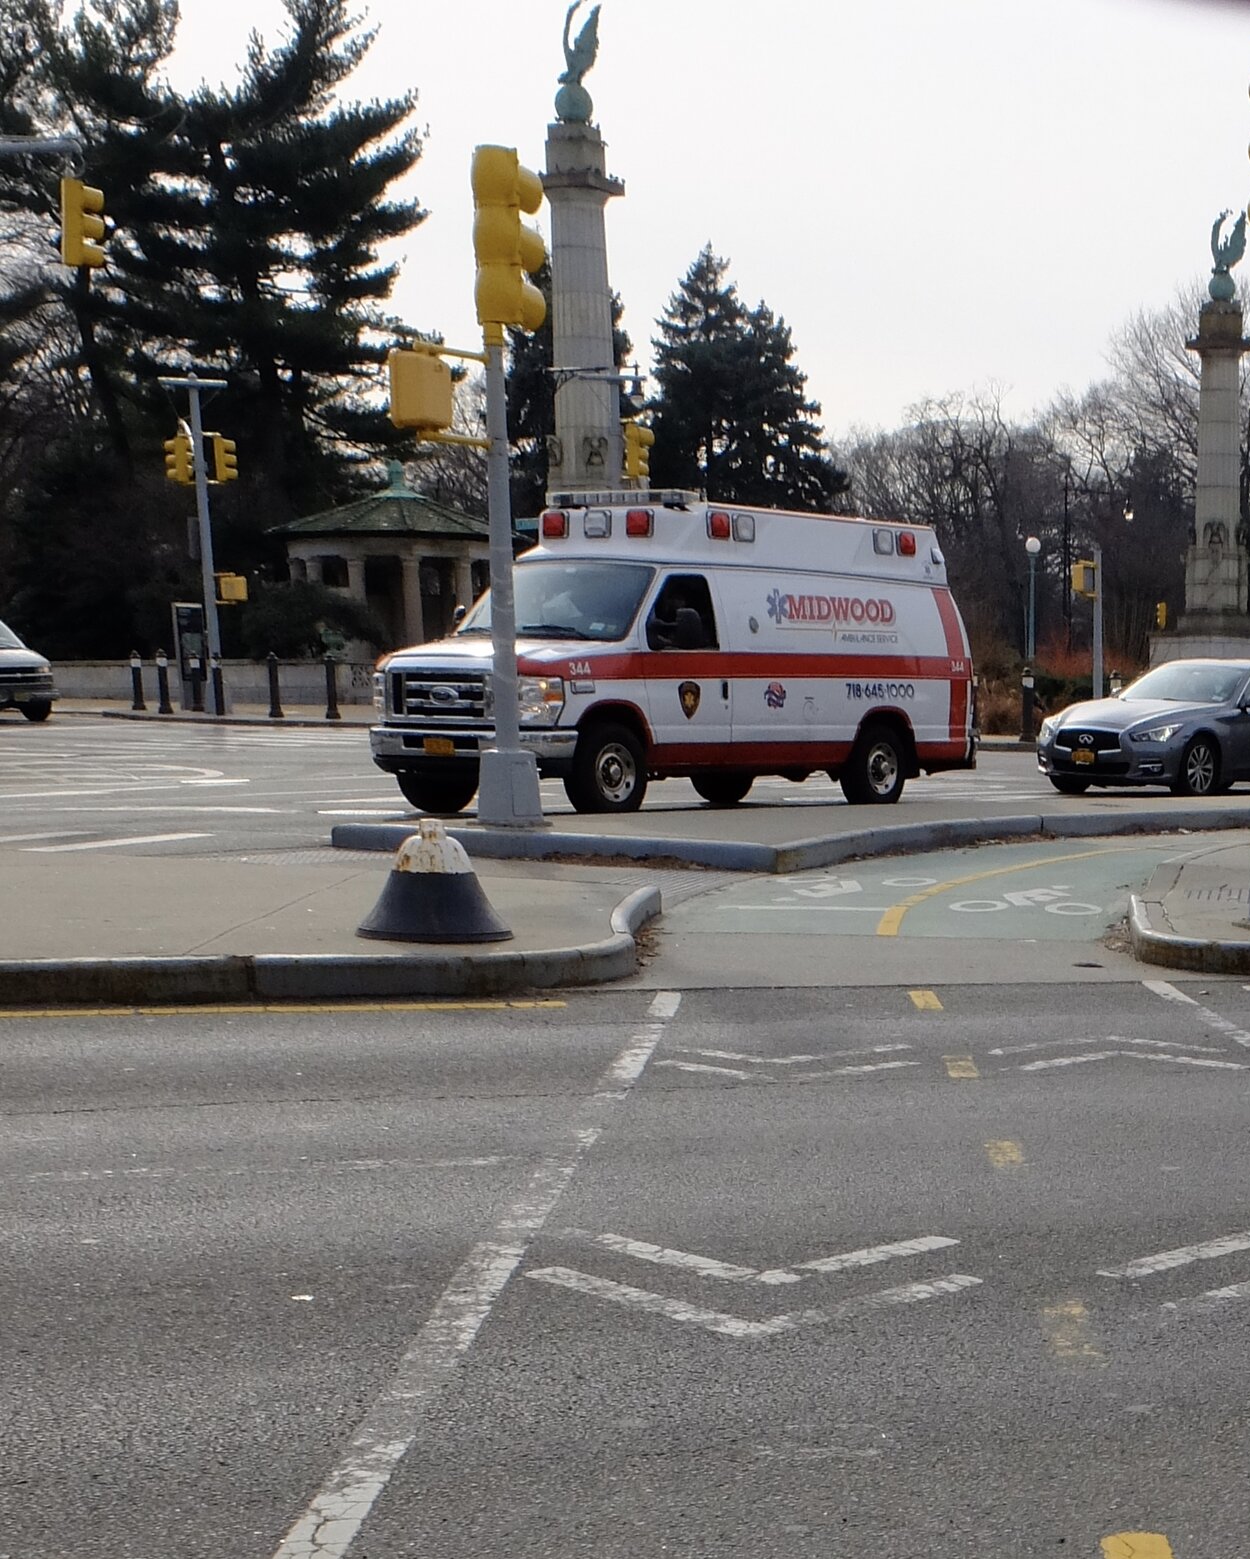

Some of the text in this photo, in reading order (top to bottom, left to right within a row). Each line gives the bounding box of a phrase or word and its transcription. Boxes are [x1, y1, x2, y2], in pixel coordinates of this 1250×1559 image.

[786, 594, 896, 625] MIDWOOD
[569, 661, 591, 675] 344
[951, 660, 965, 673] 344
